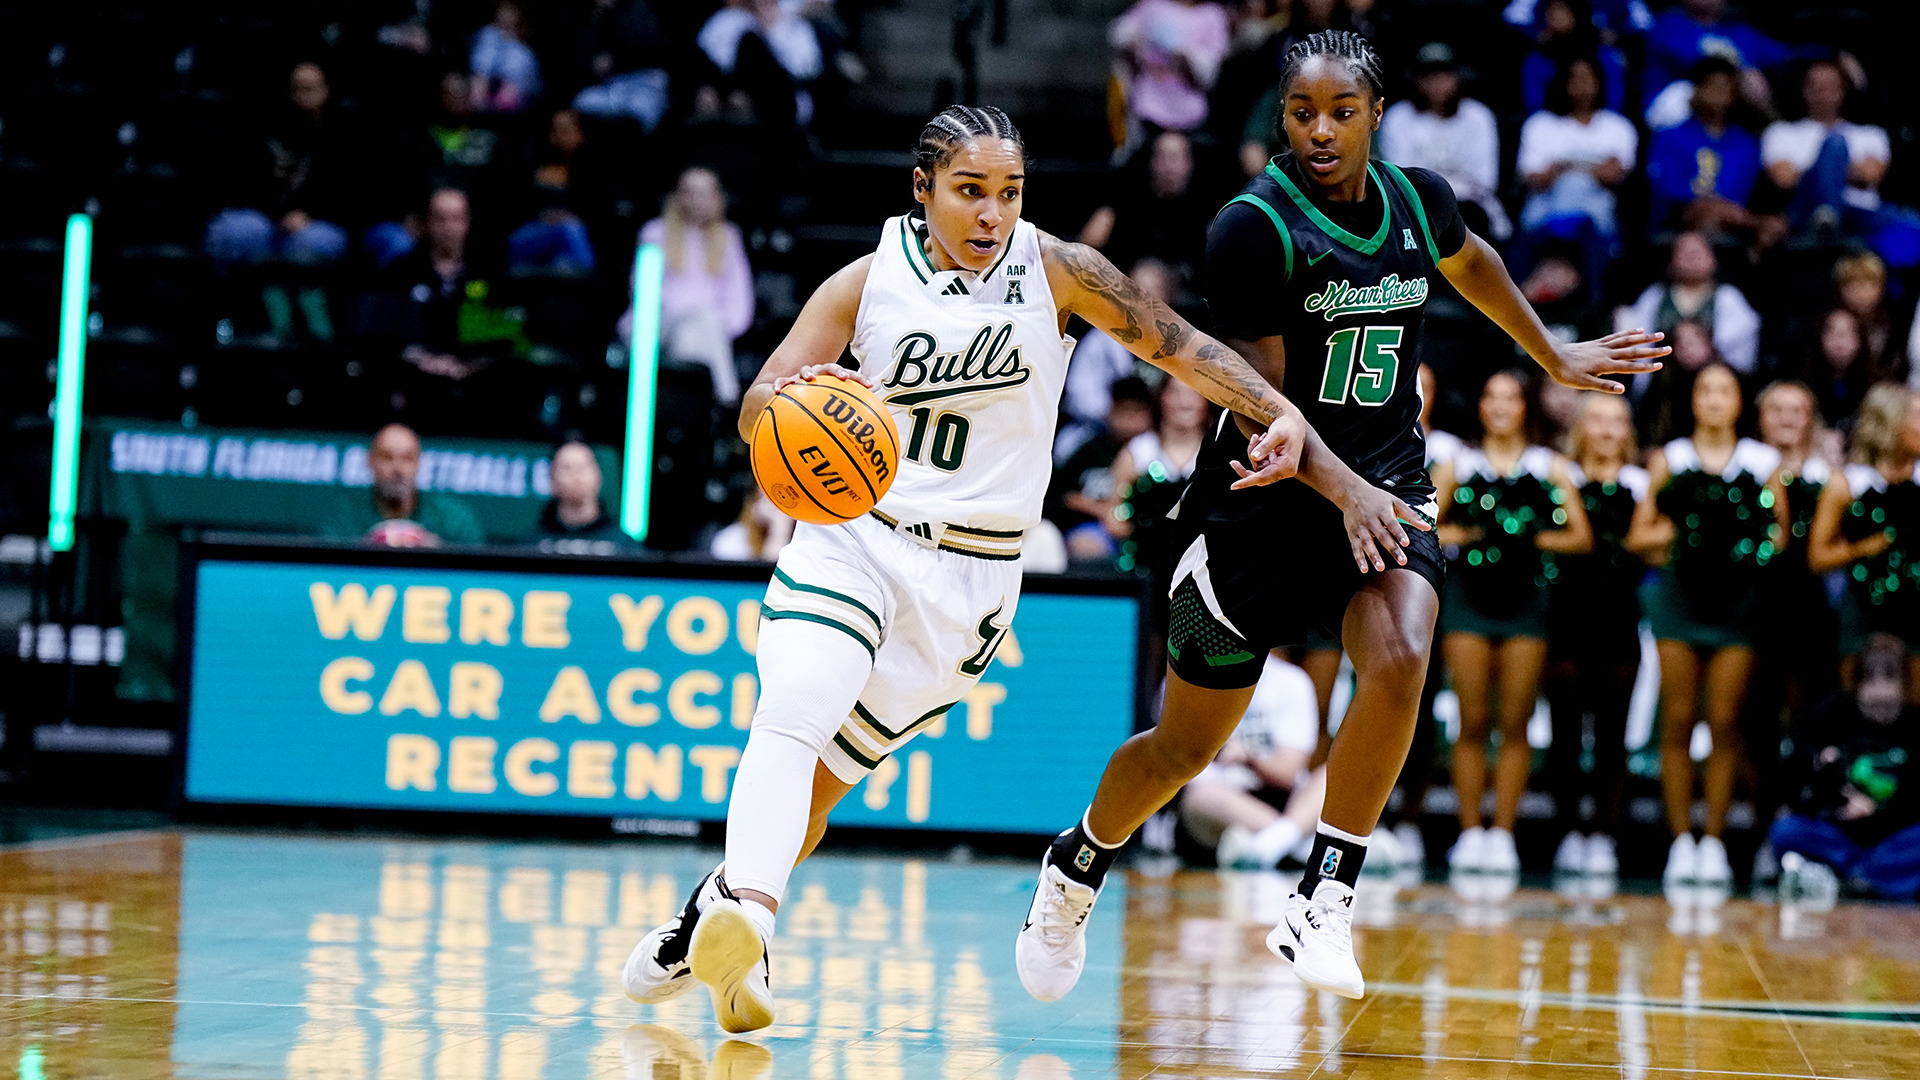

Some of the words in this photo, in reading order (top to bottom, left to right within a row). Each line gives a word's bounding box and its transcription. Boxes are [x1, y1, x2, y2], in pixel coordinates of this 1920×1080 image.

[1006, 264, 1027, 277] AAR
[882, 320, 1032, 392] Bulls
[1318, 325, 1405, 407] 15
[822, 393, 889, 484] Wilson
[902, 406, 973, 475] 10
[309, 582, 572, 649] WERE
[319, 656, 504, 720] CAR
